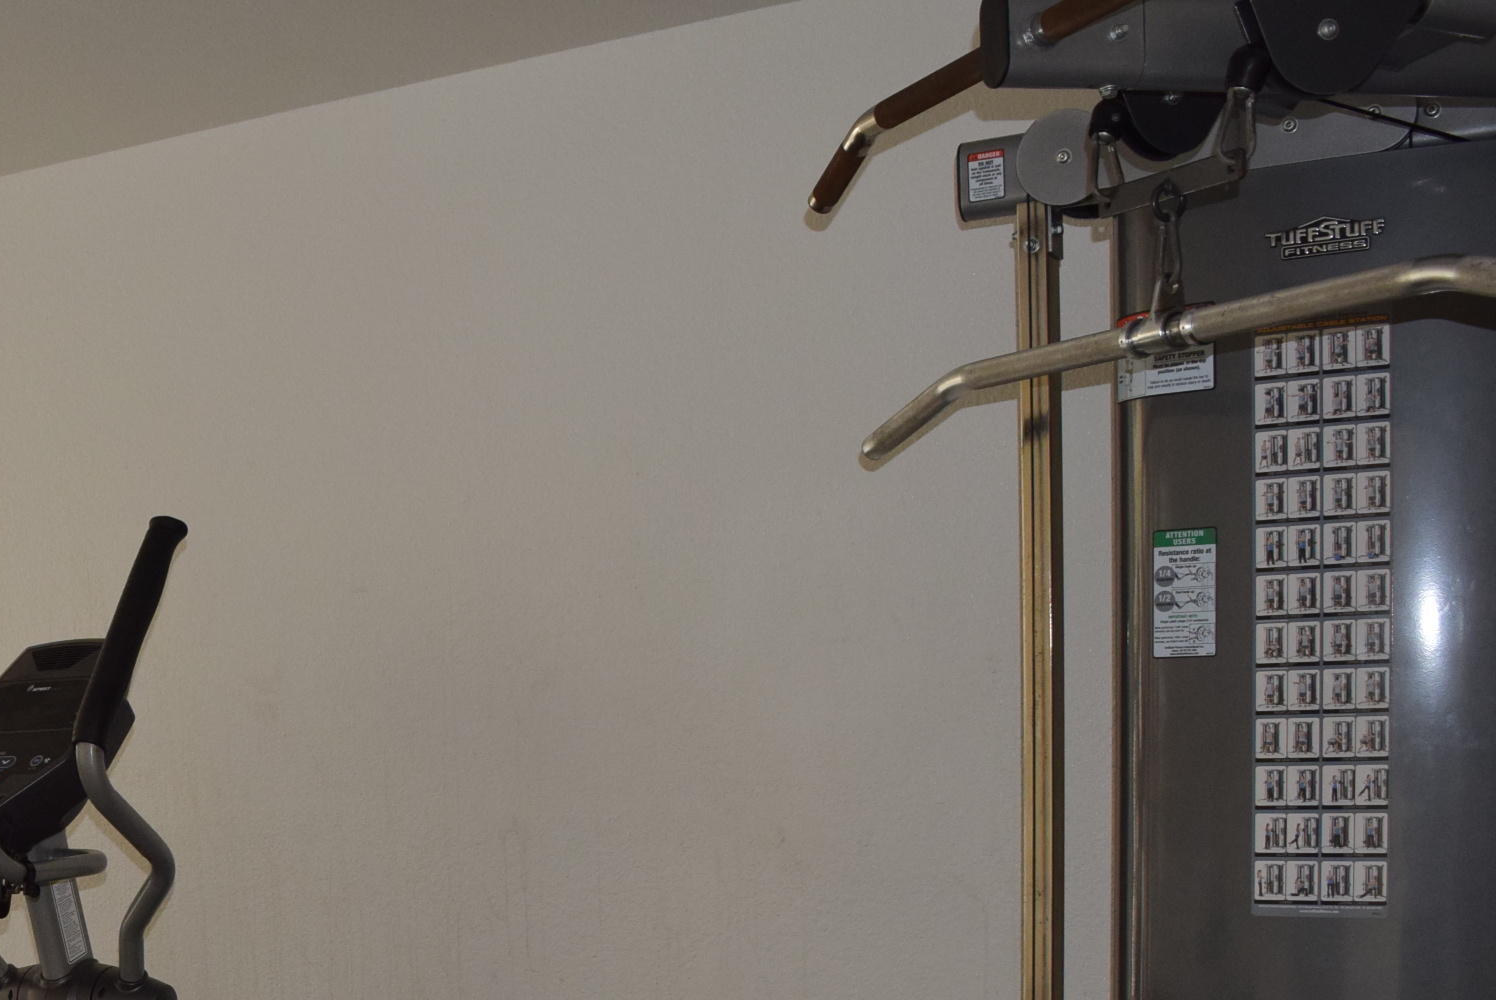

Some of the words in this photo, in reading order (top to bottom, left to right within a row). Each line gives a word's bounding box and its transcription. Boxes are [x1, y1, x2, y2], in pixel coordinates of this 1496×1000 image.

[1264, 219, 1385, 247] TUFFSTUFF
[1284, 239, 1367, 257] FITNESS
[1165, 529, 1204, 539] ATTENTION
[1158, 549, 1190, 557] Resistance
